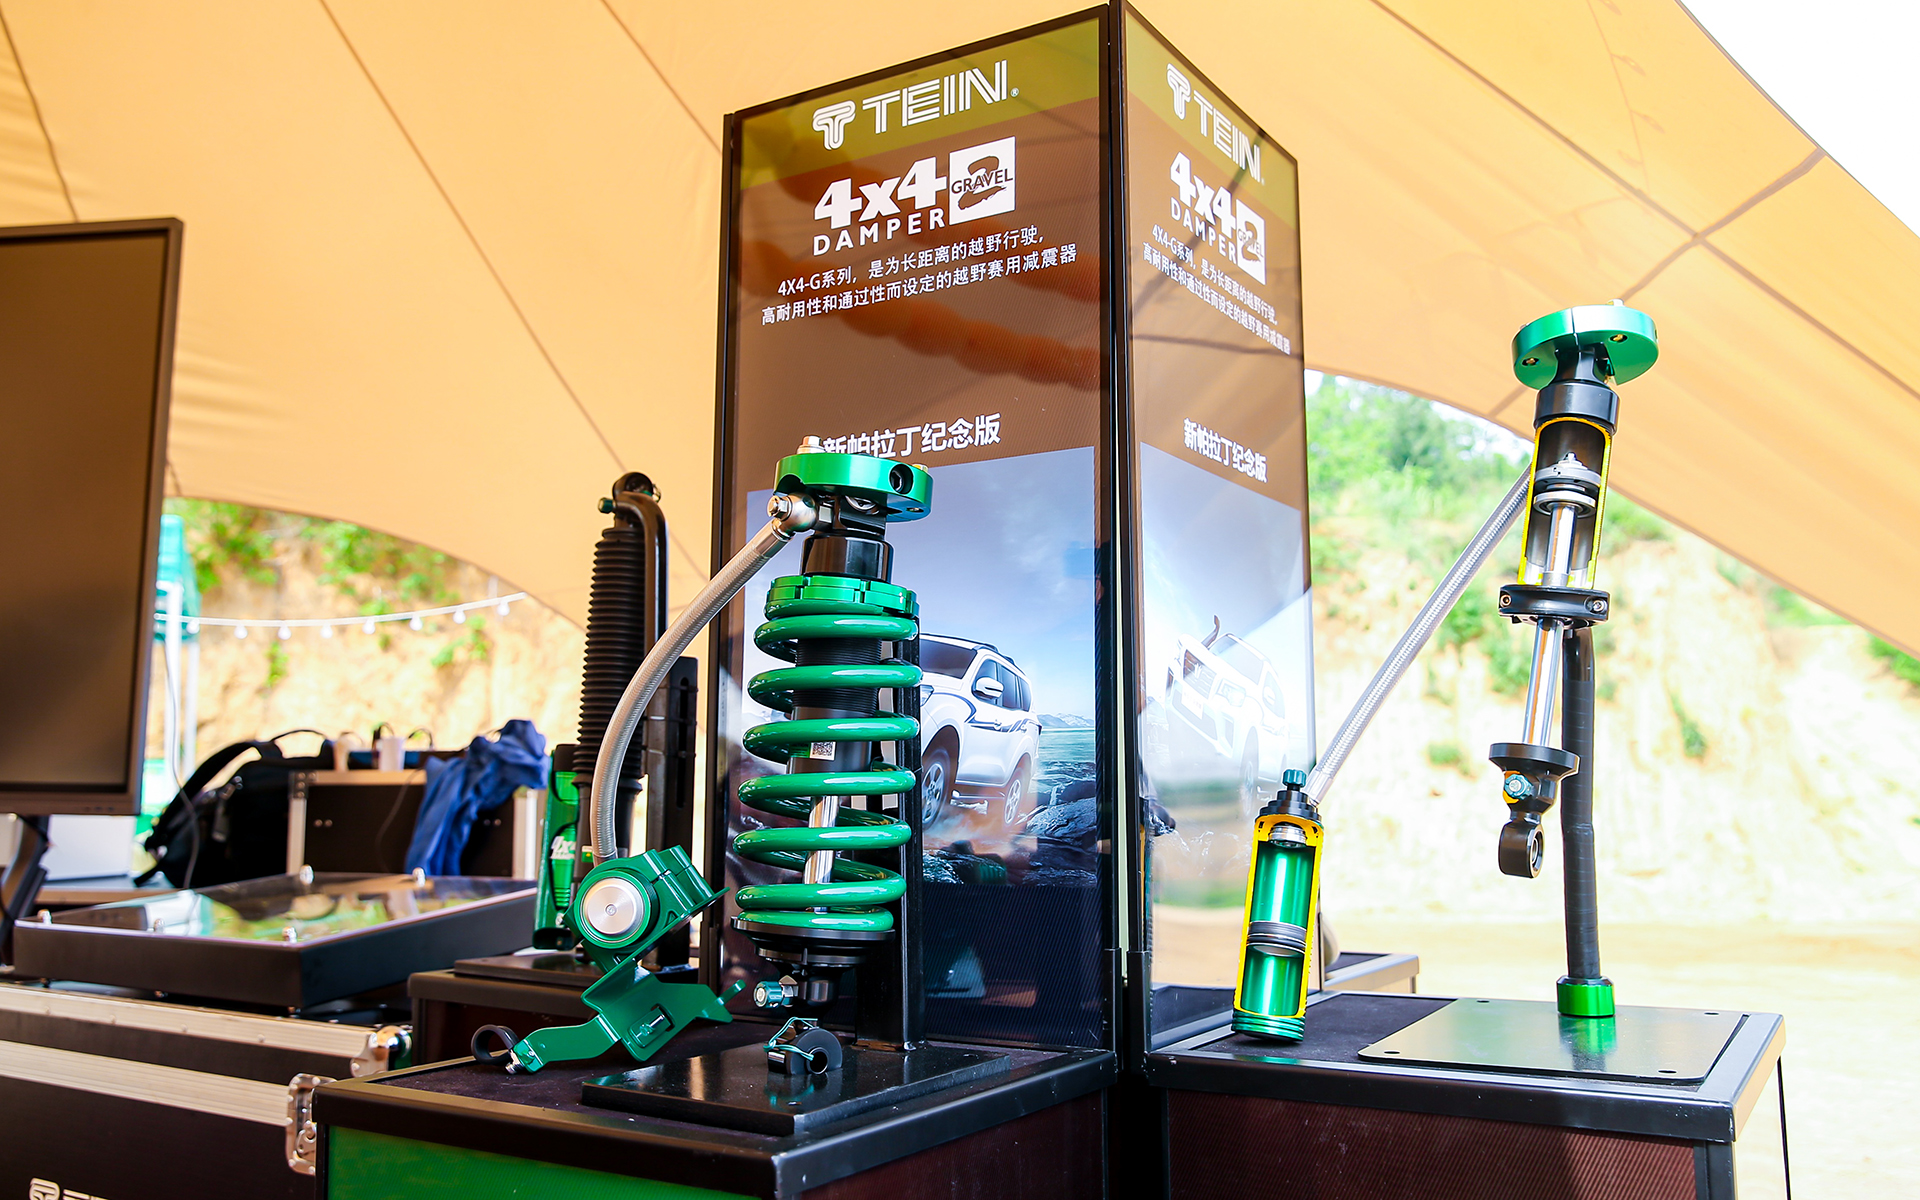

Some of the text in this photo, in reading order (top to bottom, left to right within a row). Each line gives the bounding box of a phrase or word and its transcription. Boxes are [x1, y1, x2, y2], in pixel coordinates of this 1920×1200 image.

[863, 60, 1008, 134] TEIN
[1193, 90, 1260, 183] TEIN
[814, 156, 947, 229] 4x4
[951, 168, 1014, 194] GRAVEL
[1170, 152, 1236, 238] 4x4
[813, 207, 945, 256] DAMPER
[1171, 197, 1237, 264] DAMPER
[761, 243, 1077, 326] 高耐用性和通过性而设定的越野赛用减震器
[823, 412, 1001, 458] 新帕拉丁纪念版
[1183, 417, 1268, 484] 新帕拉丁纪念版
